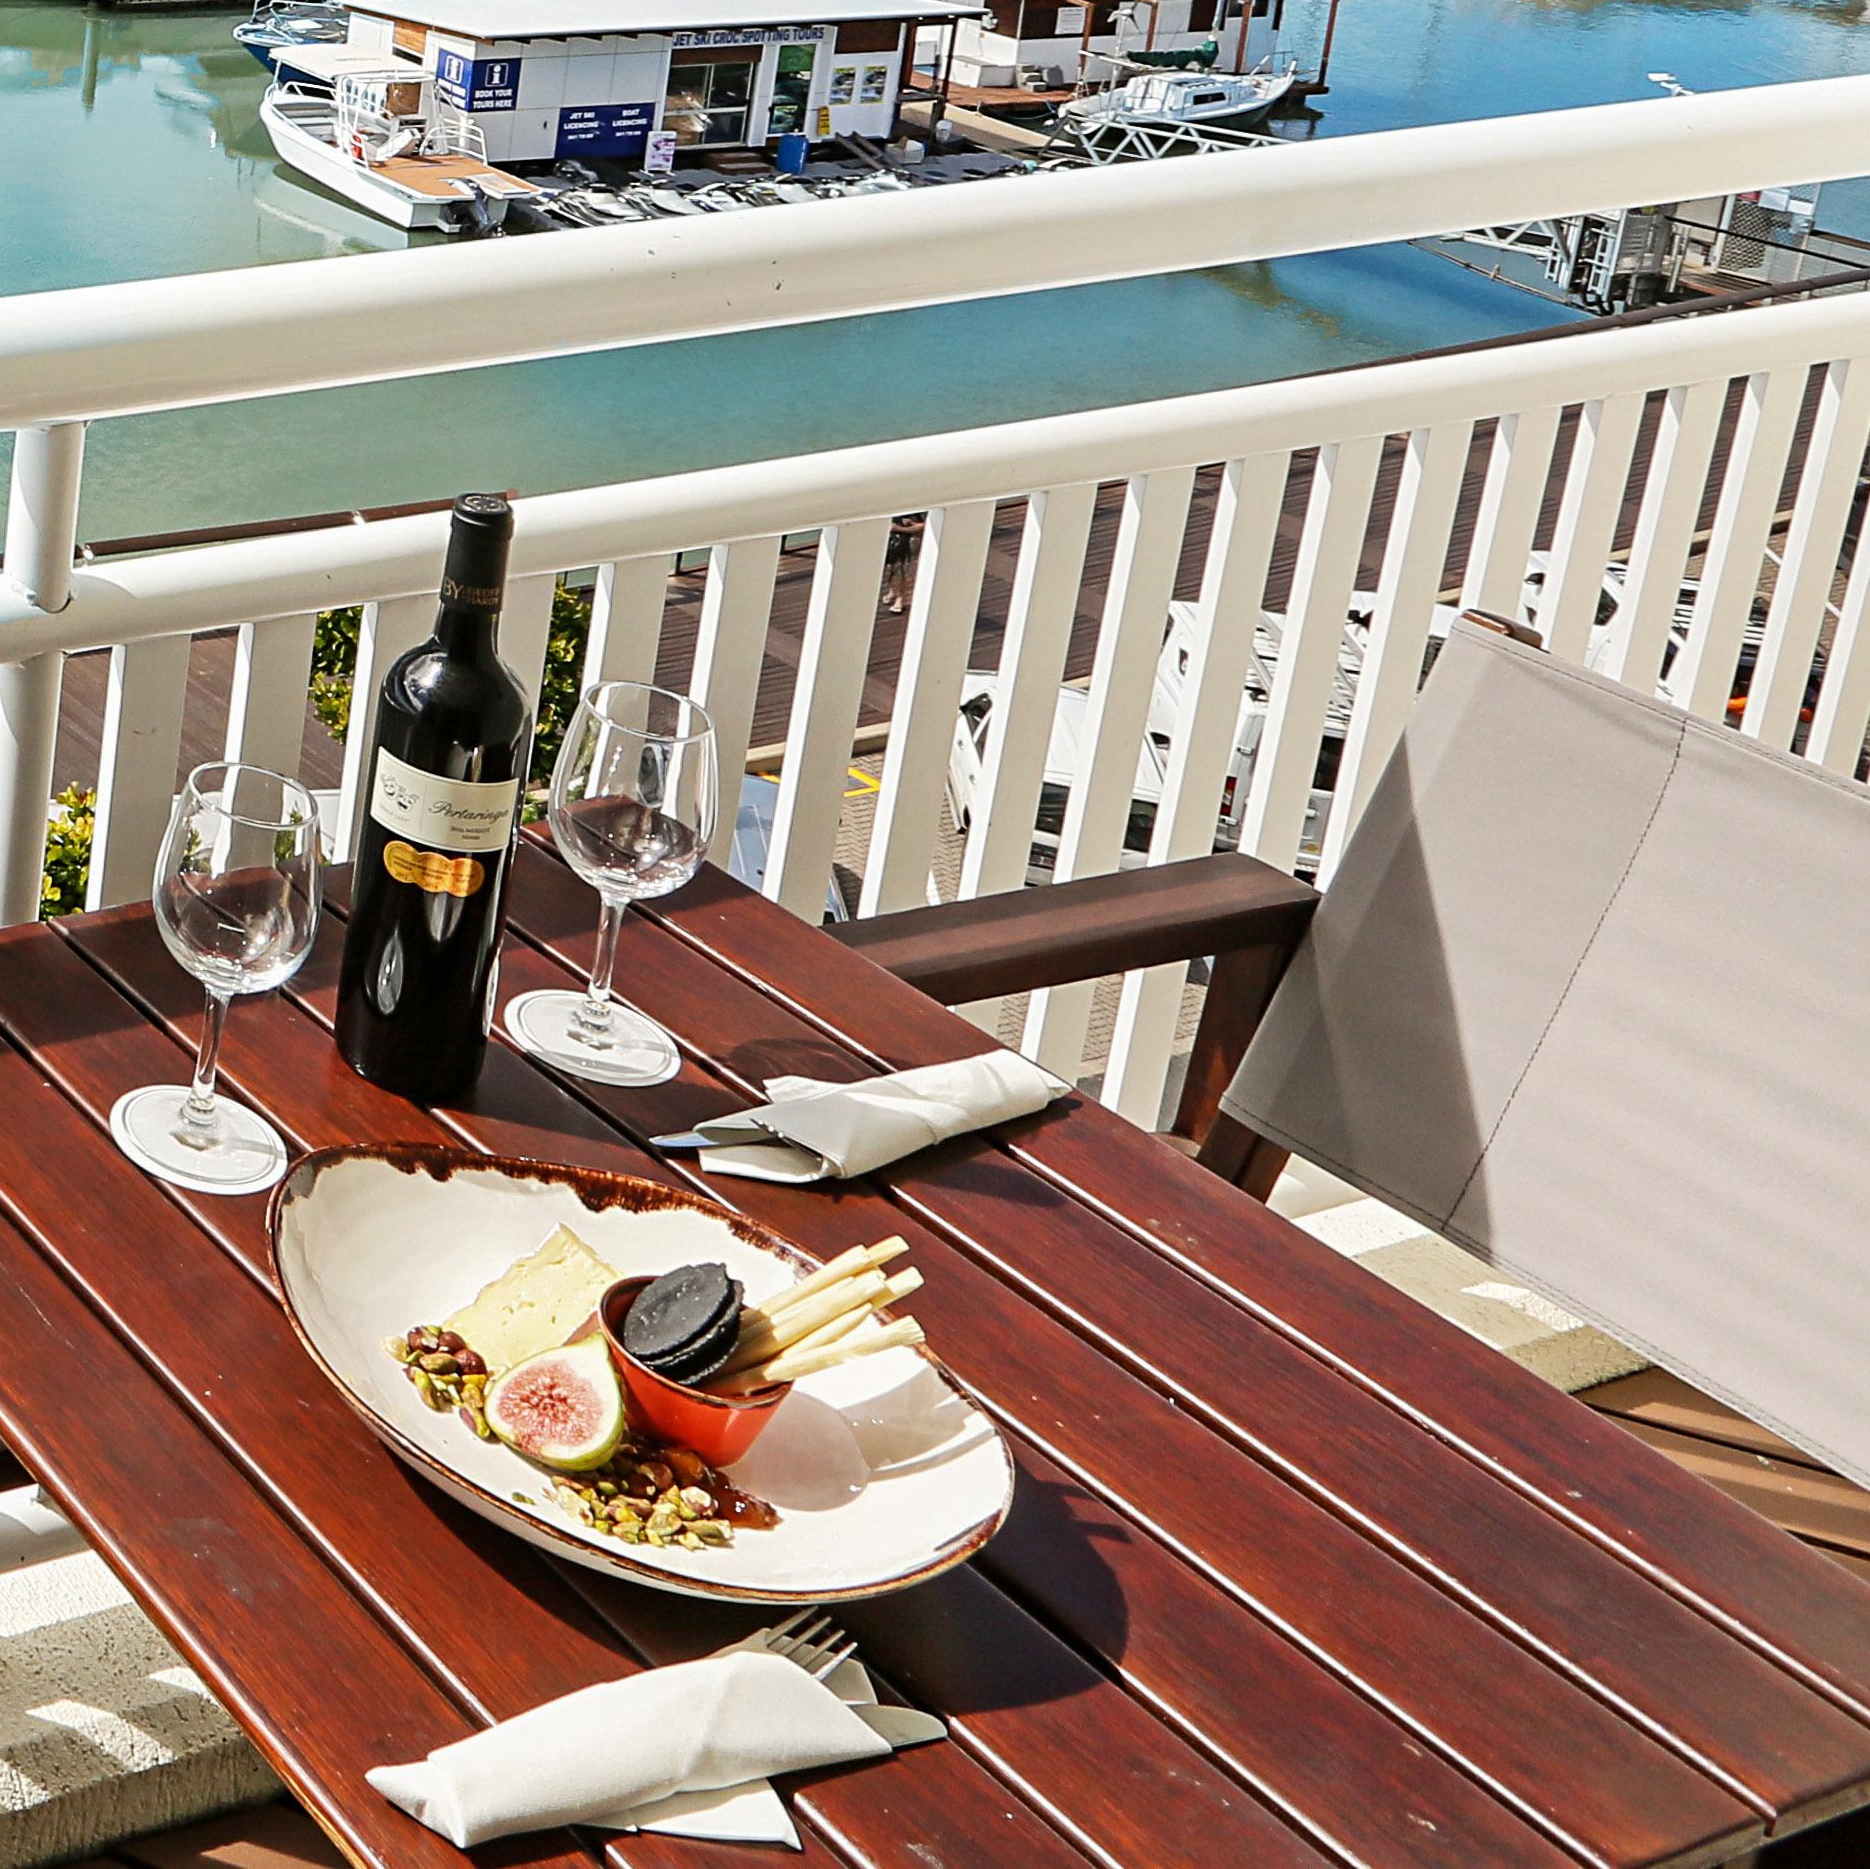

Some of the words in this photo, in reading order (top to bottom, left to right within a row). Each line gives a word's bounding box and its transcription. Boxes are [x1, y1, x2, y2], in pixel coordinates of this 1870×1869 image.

[672, 33, 692, 47] JET
[693, 32, 710, 46] SKI
[712, 31, 739, 45] CROC
[740, 28, 791, 43] SPOTTING
[792, 26, 825, 41] TOURS
[474, 89, 494, 99] BOOK
[494, 88, 513, 98] YOUR
[472, 100, 495, 109] TOURS
[494, 99, 513, 108] HERE
[569, 112, 583, 120] JET
[583, 111, 596, 119] SKI
[622, 108, 640, 117] BOAT
[563, 120, 600, 130] LICENCING
[612, 117, 648, 127] LICENCING
[443, 576, 464, 600] BY
[429, 801, 509, 824] Pertaringa
